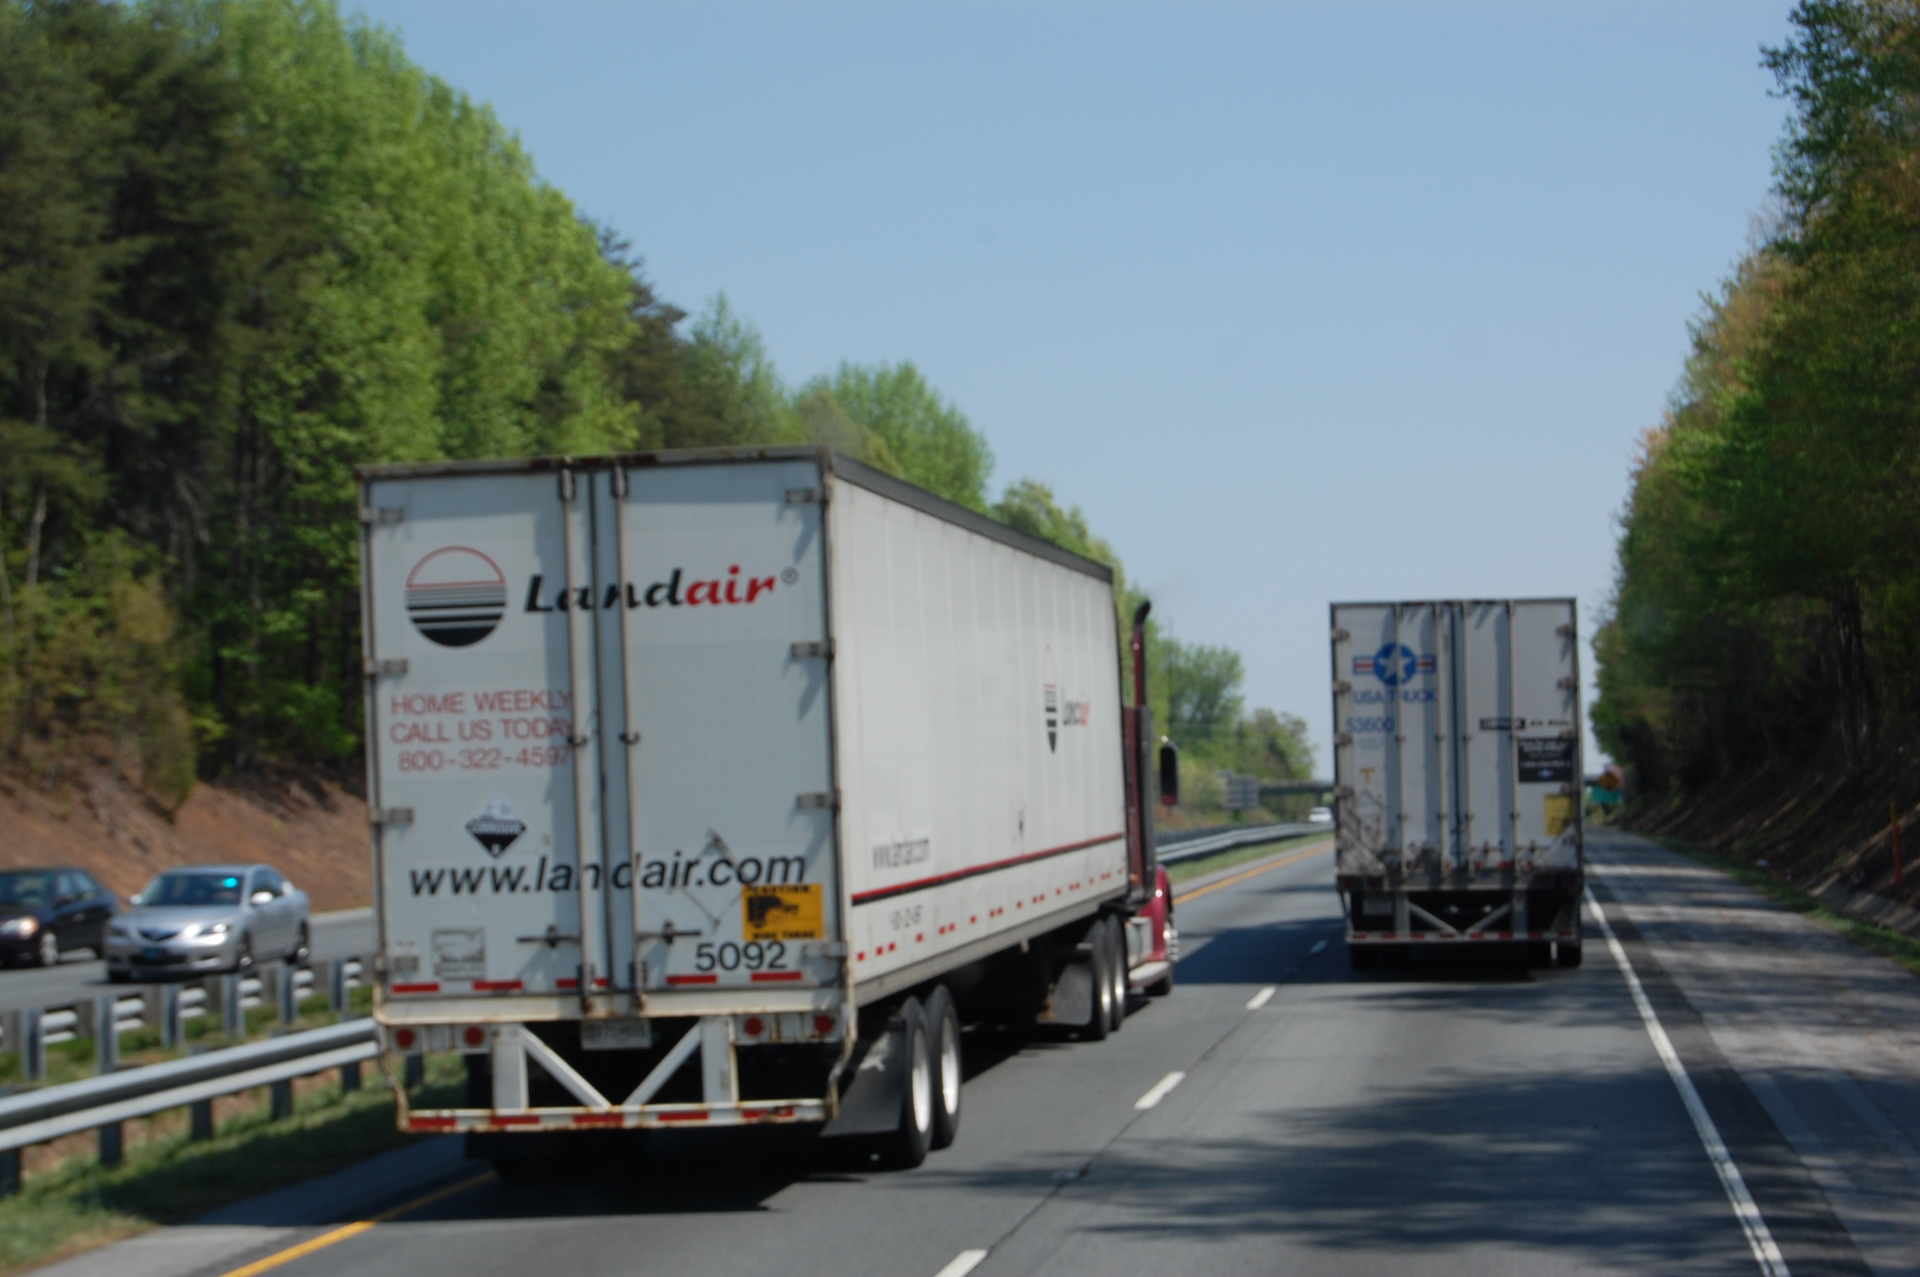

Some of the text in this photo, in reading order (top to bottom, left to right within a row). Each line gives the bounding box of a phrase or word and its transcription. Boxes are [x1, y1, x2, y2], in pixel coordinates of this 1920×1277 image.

[524, 564, 775, 613] Landair
[390, 689, 573, 716] HOME WEEKLY
[1386, 687, 1436, 703] TUCK
[389, 722, 450, 744] CALL
[457, 719, 494, 742] US
[410, 851, 806, 896] www.landair.com
[696, 941, 786, 971] 5092
